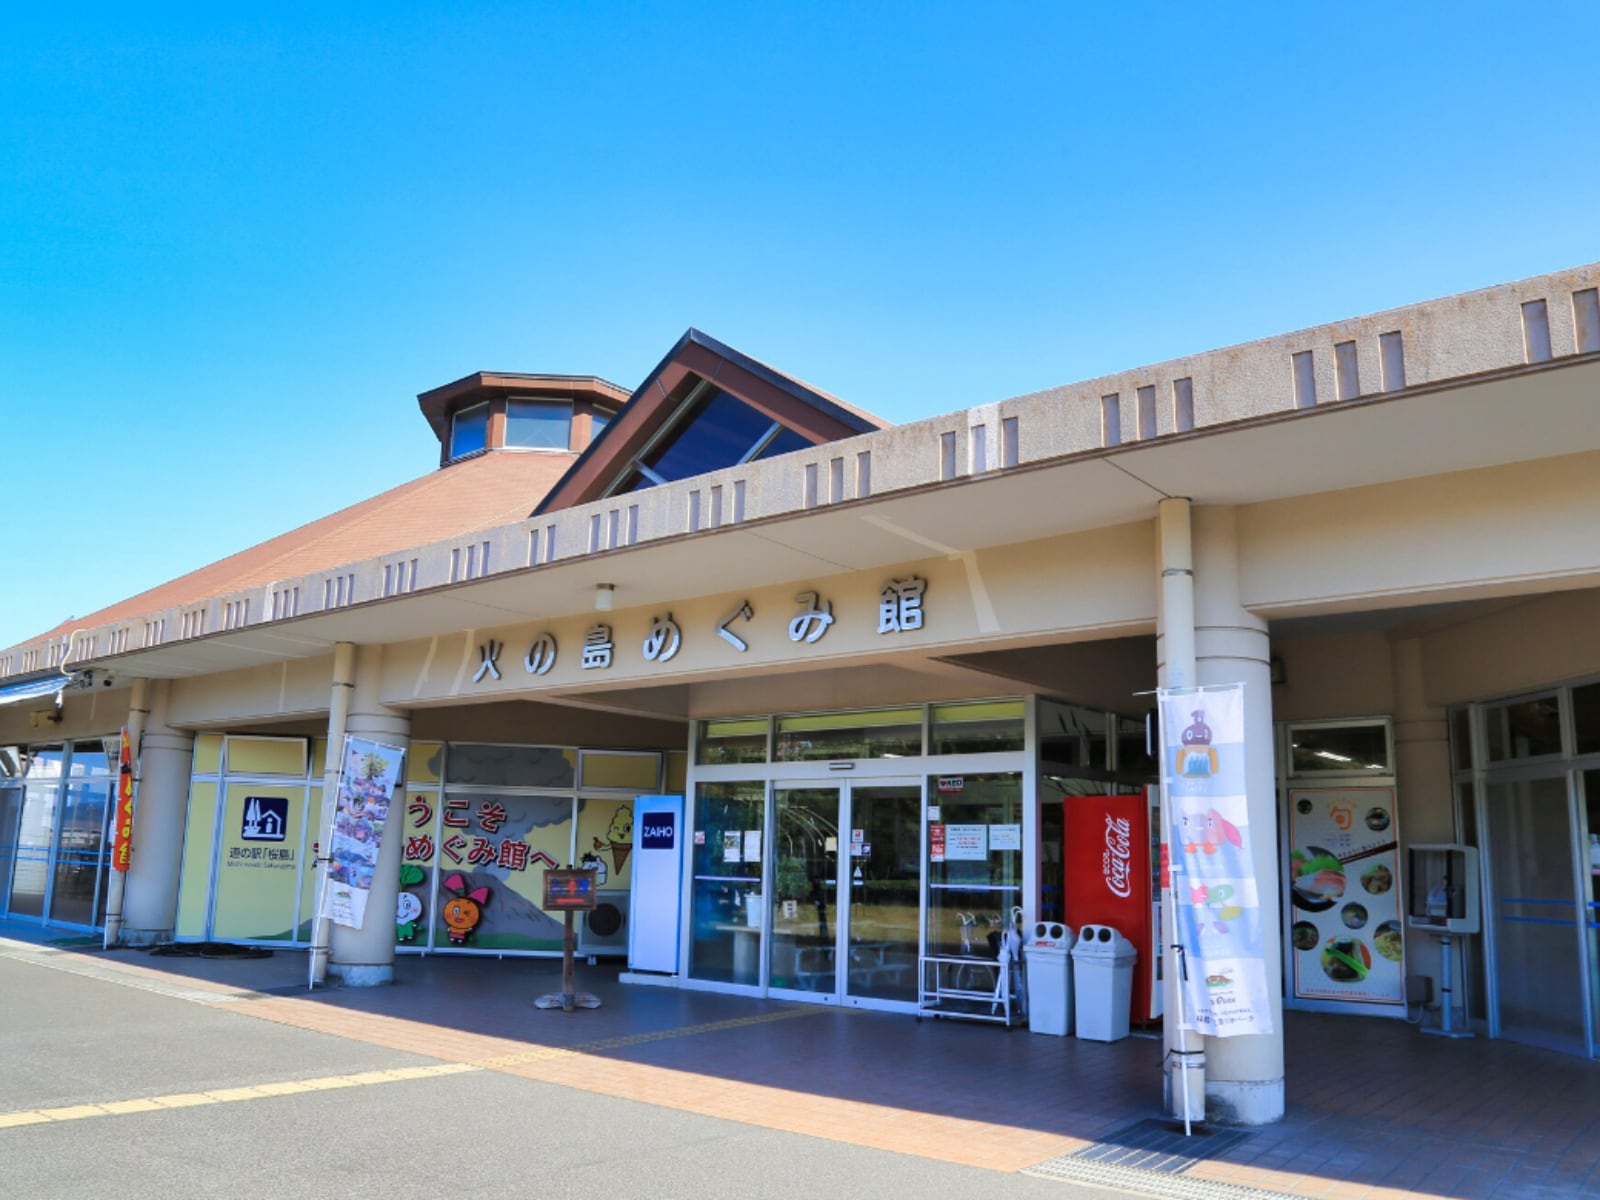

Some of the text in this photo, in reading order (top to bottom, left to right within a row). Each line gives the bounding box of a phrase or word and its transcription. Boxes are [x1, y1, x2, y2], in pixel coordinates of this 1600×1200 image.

[472, 575, 928, 683] 火の島めぐみ館
[643, 826, 673, 838] ZAIHO
[229, 847, 295, 861] 道の駅「桜島」
[404, 834, 560, 872] めぐみ館へ
[1105, 812, 1131, 898] Coca-Cola
